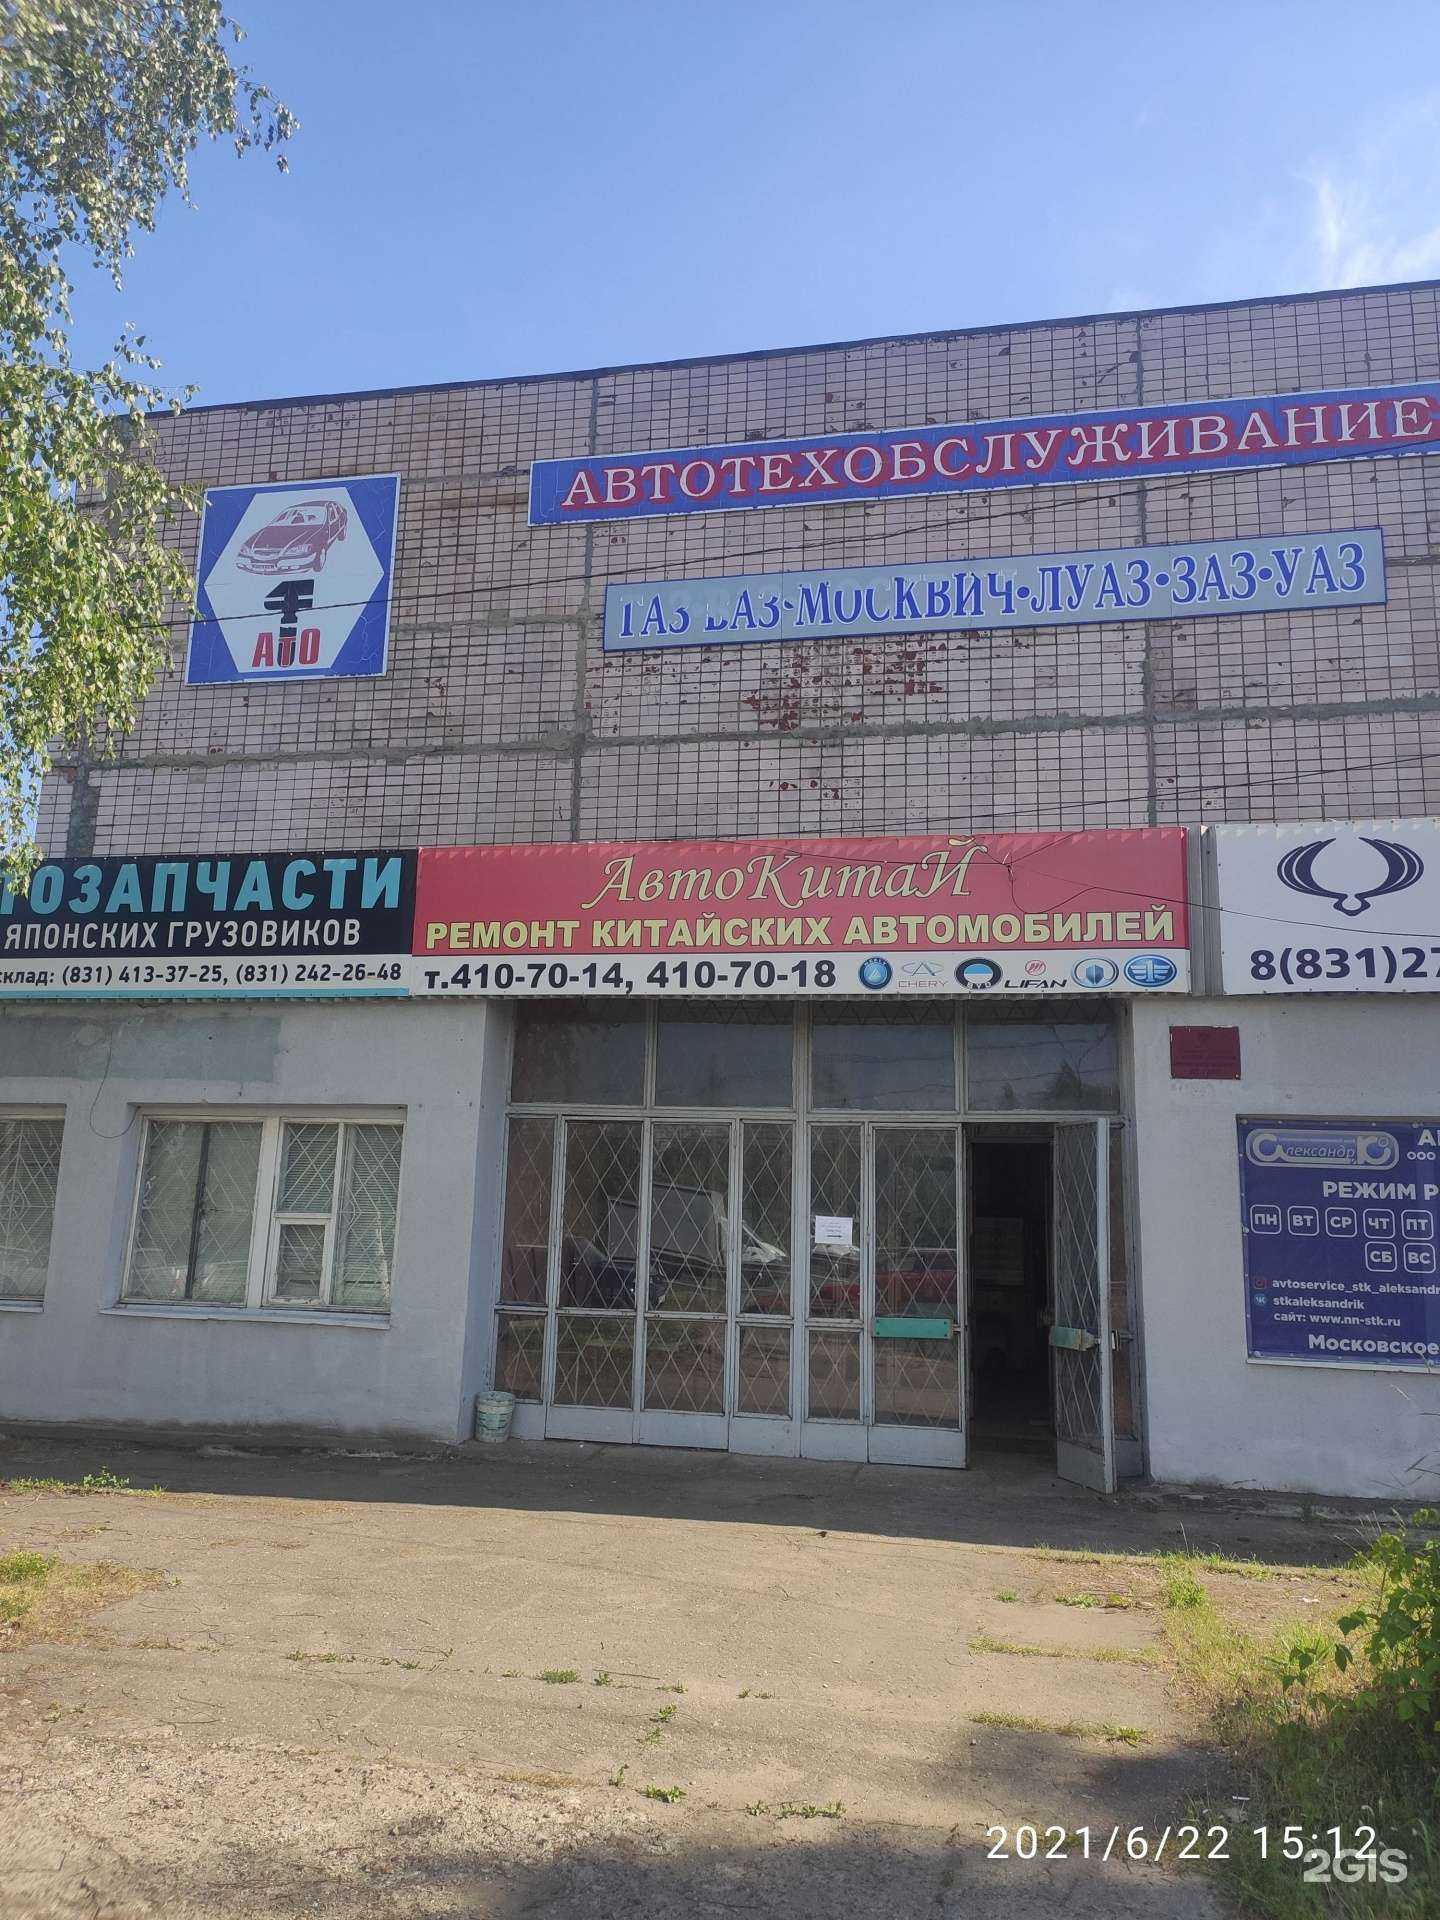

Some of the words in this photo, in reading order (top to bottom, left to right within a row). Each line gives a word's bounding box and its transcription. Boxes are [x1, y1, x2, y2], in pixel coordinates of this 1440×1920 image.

[562, 397, 1433, 506] АВТОТЕХОБСЛУЖИВАНИЕ
[4, 920, 158, 950] ЯПОНСКИХ
[167, 918, 361, 948] ГРУЗОВИКОВ
[426, 920, 580, 950] РЕМОНТ
[591, 912, 833, 948] КИТАЙСКИХ
[843, 904, 1175, 946] АВТОМОБИЛЕЙ
[0, 967, 54, 986] клад:
[61, 965, 113, 986] (831)
[118, 964, 228, 987] 413-37-25,
[236, 963, 289, 985] (831)
[294, 962, 402, 983] 242-26-48
[424, 962, 635, 994] т.410-70-14,
[646, 958, 836, 990] 410-70-18
[897, 980, 948, 988] CHERY
[1004, 979, 1068, 989] LIFAN
[1322, 1180, 1417, 1200] РЕЖИМ
[1254, 1213, 1278, 1226] ПН
[1292, 1214, 1314, 1227] ВТ
[1329, 1216, 1352, 1229] СР
[1368, 1217, 1390, 1230] ЧТ
[1406, 1218, 1429, 1231] ПТ
[1370, 1250, 1393, 1263] СБ
[1407, 1252, 1431, 1265] ВС
[1273, 1296, 1365, 1310] stkaleksandrik
[1274, 1311, 1307, 1323] сайт:
[1309, 1313, 1401, 1327] www.nn-stk.ru
[1308, 1334, 1440, 1355] Московское
